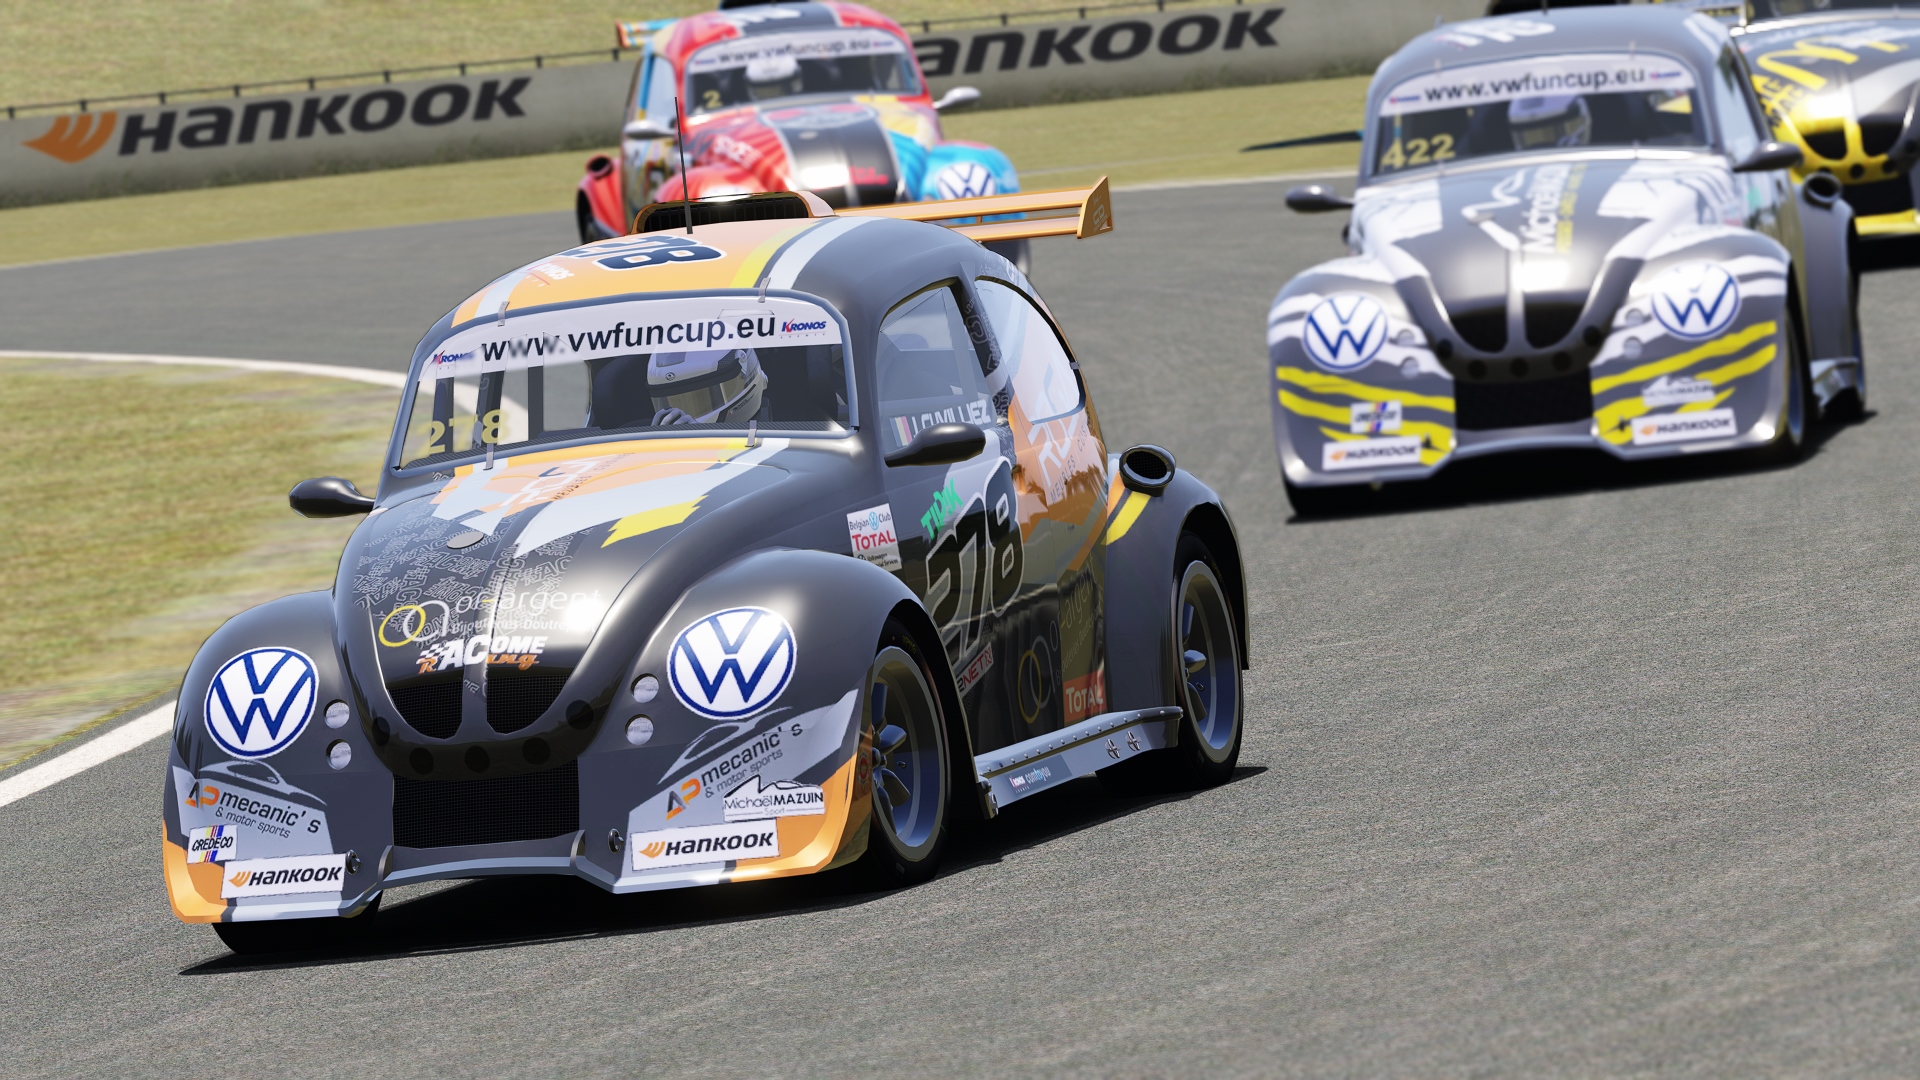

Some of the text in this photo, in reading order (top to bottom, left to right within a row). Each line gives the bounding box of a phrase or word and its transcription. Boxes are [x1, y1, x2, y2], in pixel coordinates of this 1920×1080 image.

[912, 8, 1286, 77] ANKOOK
[703, 91, 723, 109] 2
[1425, 69, 1645, 102] www.vwfuncup.eu
[1380, 133, 1456, 171] 422
[481, 316, 776, 362] www.vwfuncup.eu
[781, 318, 827, 333] KRONOS
[415, 408, 511, 455] 278
[878, 512, 892, 523] Club
[852, 530, 896, 551] TOTAL
[926, 455, 1025, 658] 278
[1065, 684, 1104, 715] TOTAL
[716, 768, 747, 792] motor
[750, 749, 784, 773] sports
[226, 811, 257, 828] motor
[257, 821, 291, 839] sports
[191, 836, 234, 852] CREDECO
